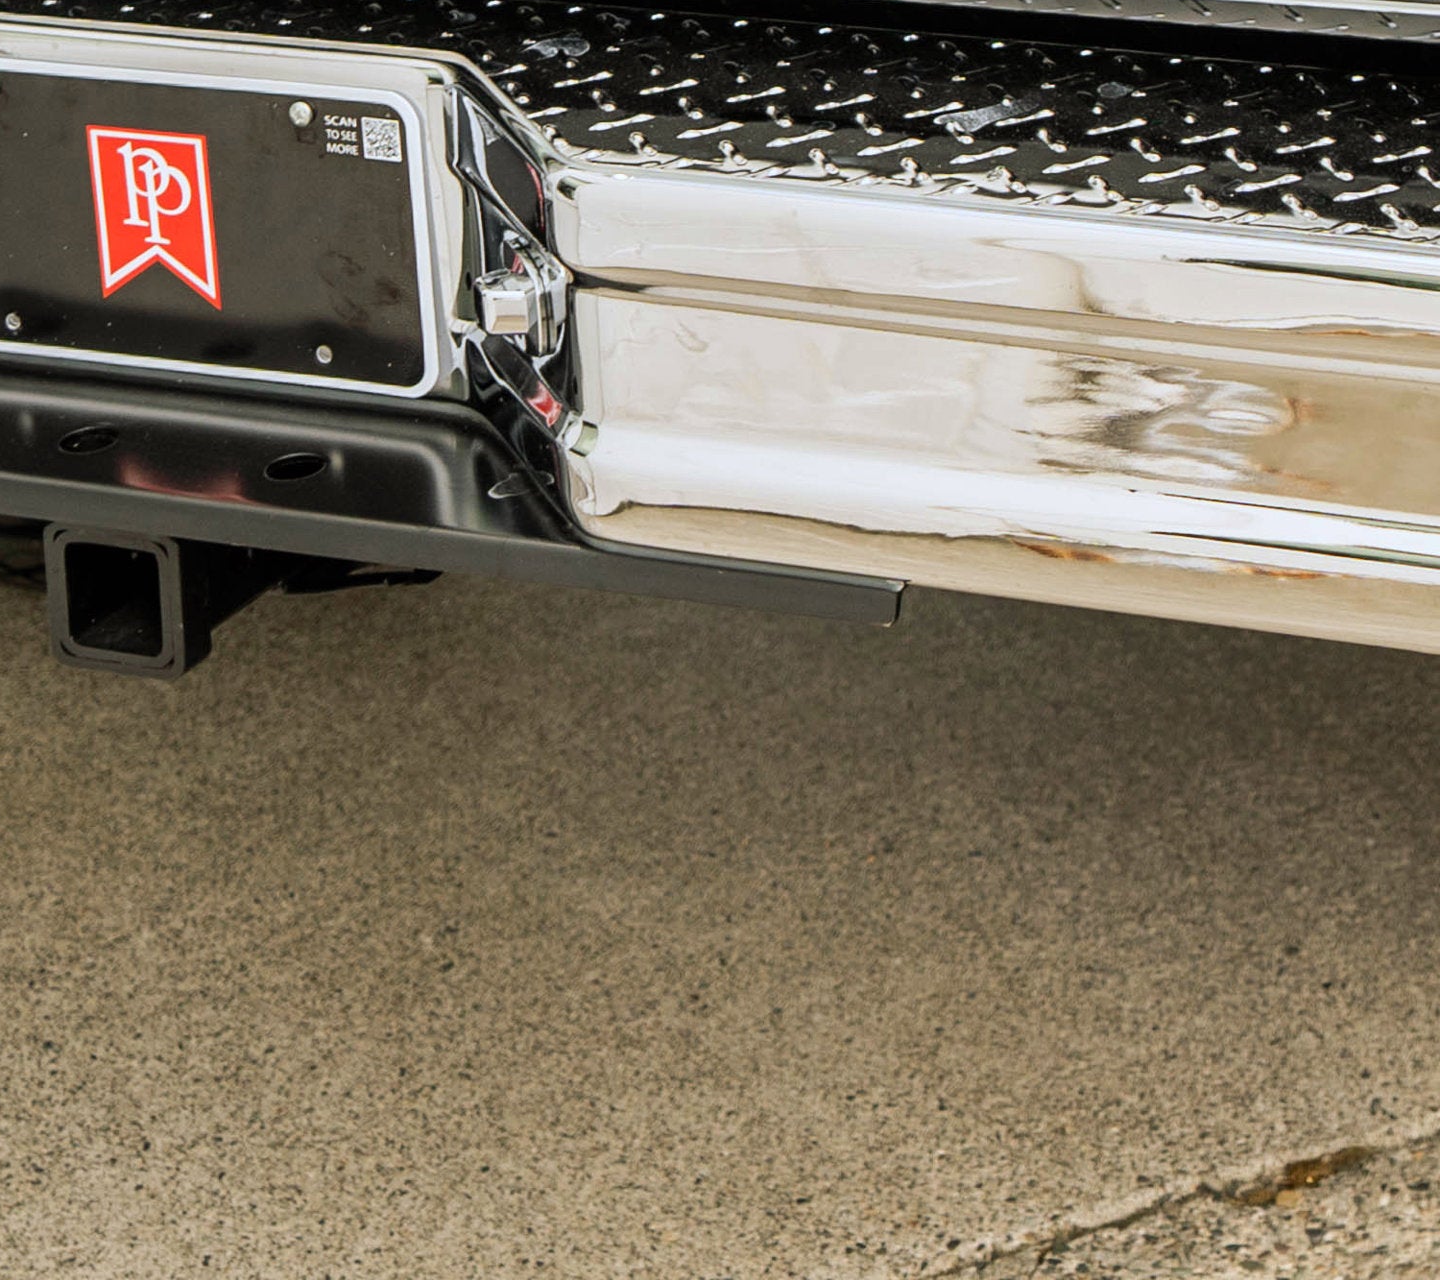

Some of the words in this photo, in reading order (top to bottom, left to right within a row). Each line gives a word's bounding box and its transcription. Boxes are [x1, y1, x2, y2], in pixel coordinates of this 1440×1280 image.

[323, 114, 358, 128] SCAN
[325, 128, 340, 140] TO
[340, 130, 358, 142] SEE
[326, 142, 360, 156] MORE
